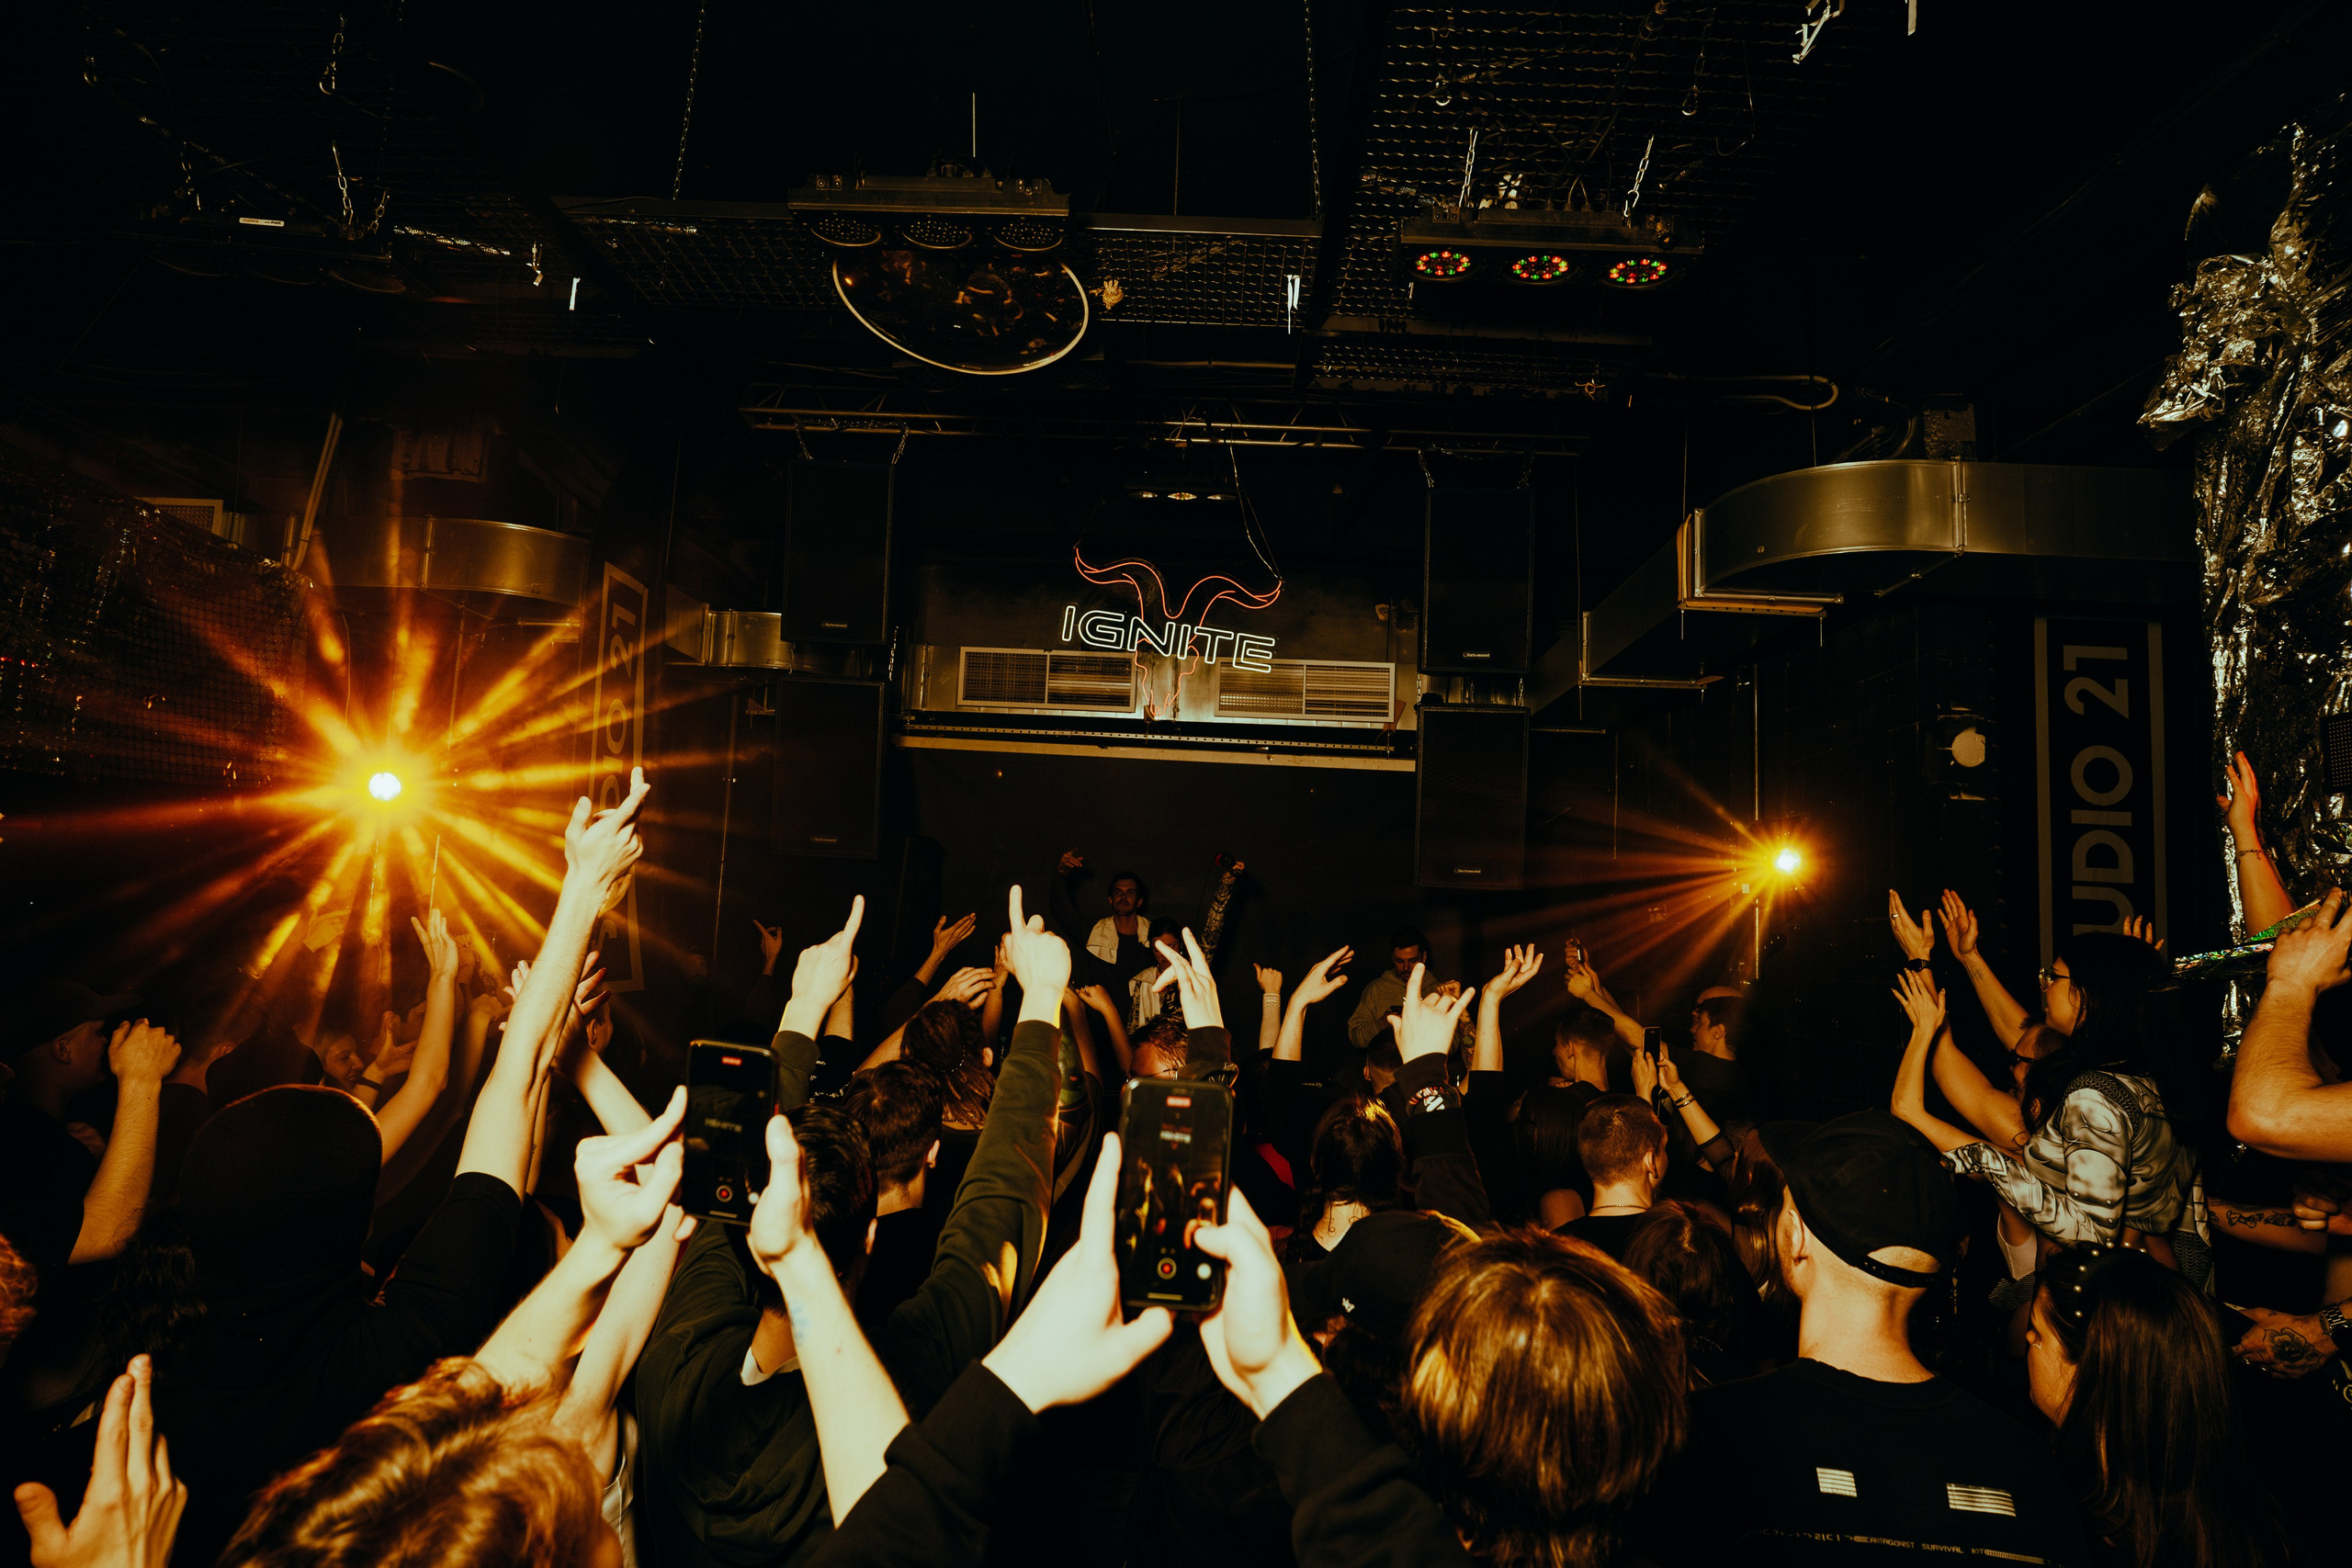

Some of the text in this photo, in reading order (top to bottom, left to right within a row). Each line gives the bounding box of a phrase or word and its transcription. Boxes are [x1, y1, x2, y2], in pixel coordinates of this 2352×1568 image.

[609, 603, 637, 680] 21
[1062, 605, 1275, 673] IGNITE
[2063, 644, 2134, 937] UDIO 21
[1921, 1542, 1964, 1554] SURVIVAL
[1971, 1547, 1984, 1555] KIT
